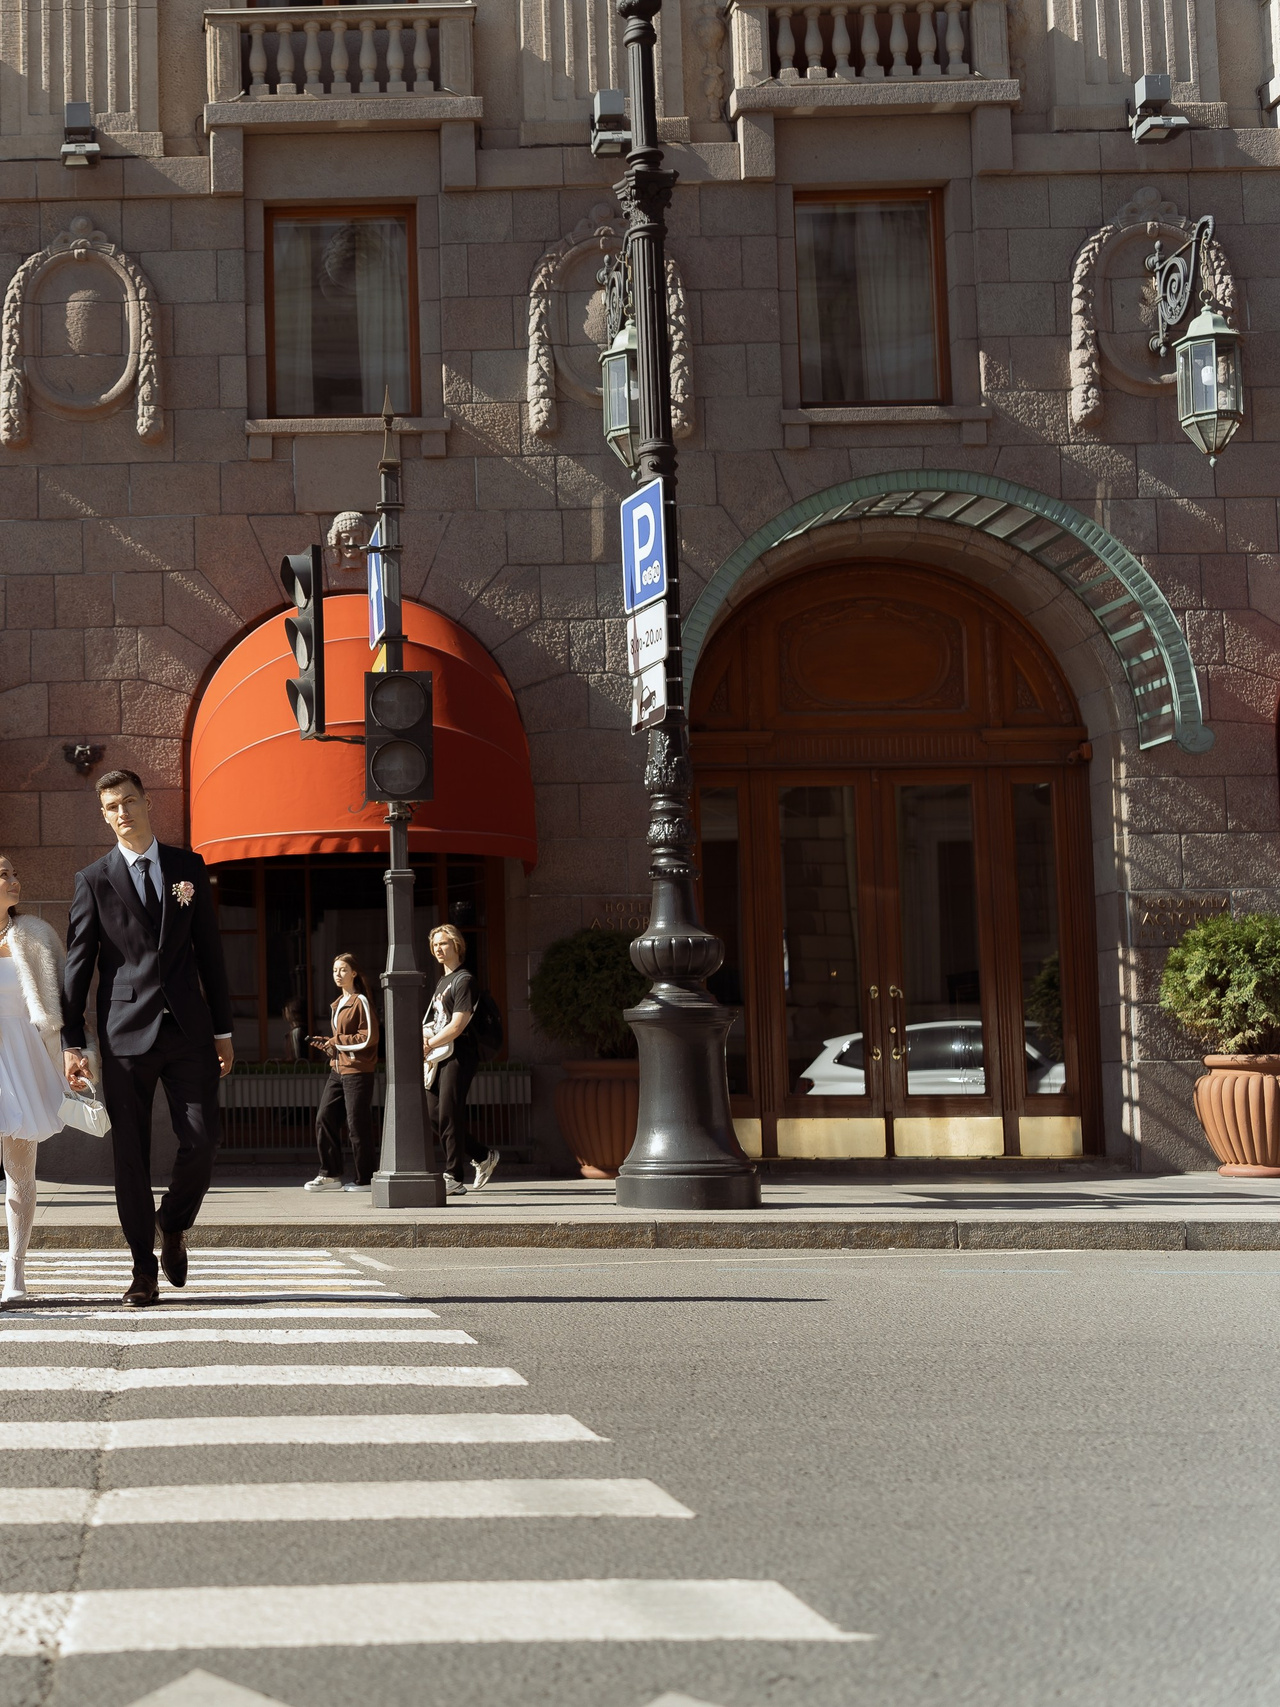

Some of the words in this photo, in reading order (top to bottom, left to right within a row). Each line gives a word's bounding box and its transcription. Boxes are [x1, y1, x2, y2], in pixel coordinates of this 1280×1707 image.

[632, 502, 655, 594] P
[630, 627, 662, 655] 8.00-20.00
[590, 916, 651, 930] ASTOR
[1142, 912, 1214, 927] АСТОР
